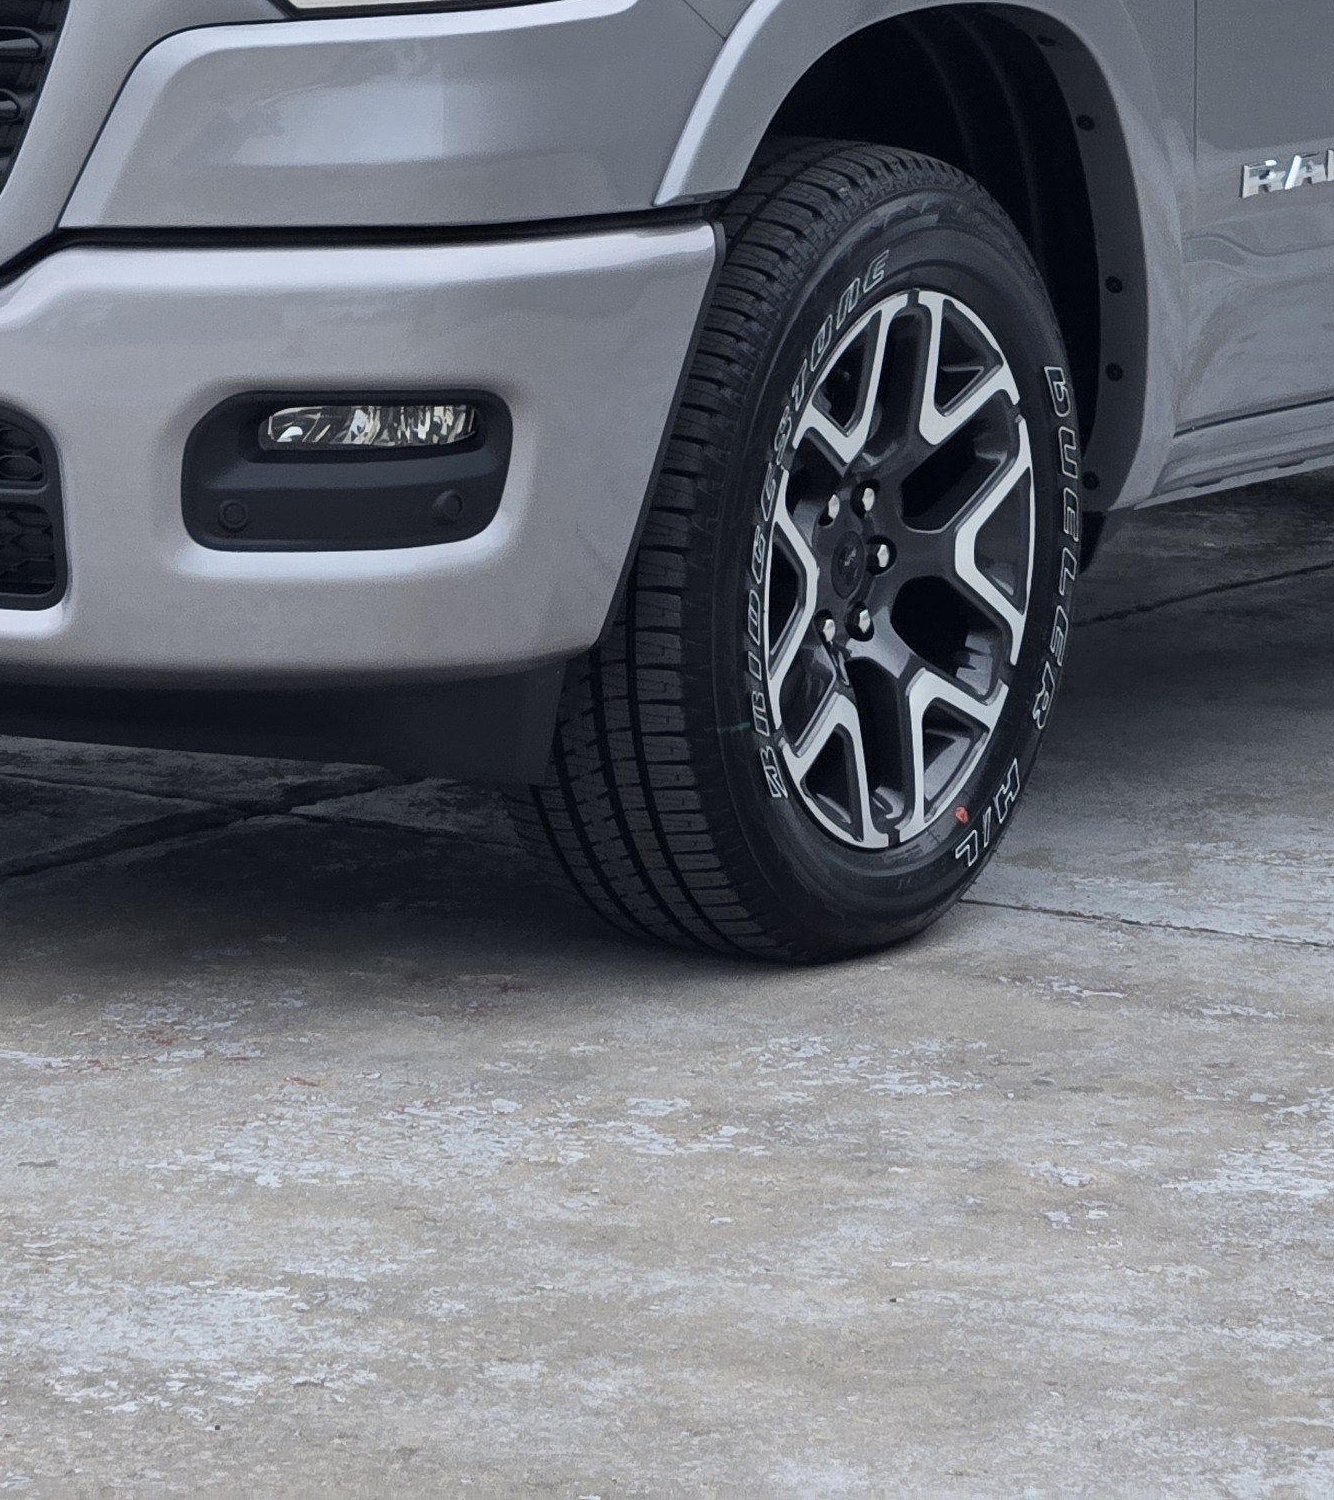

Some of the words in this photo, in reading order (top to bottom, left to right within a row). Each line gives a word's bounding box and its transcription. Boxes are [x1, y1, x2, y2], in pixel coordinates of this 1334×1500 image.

[747, 249, 889, 799] BRIDGESTONE
[1033, 365, 1080, 730] DUELER
[954, 757, 1021, 868] H/L
